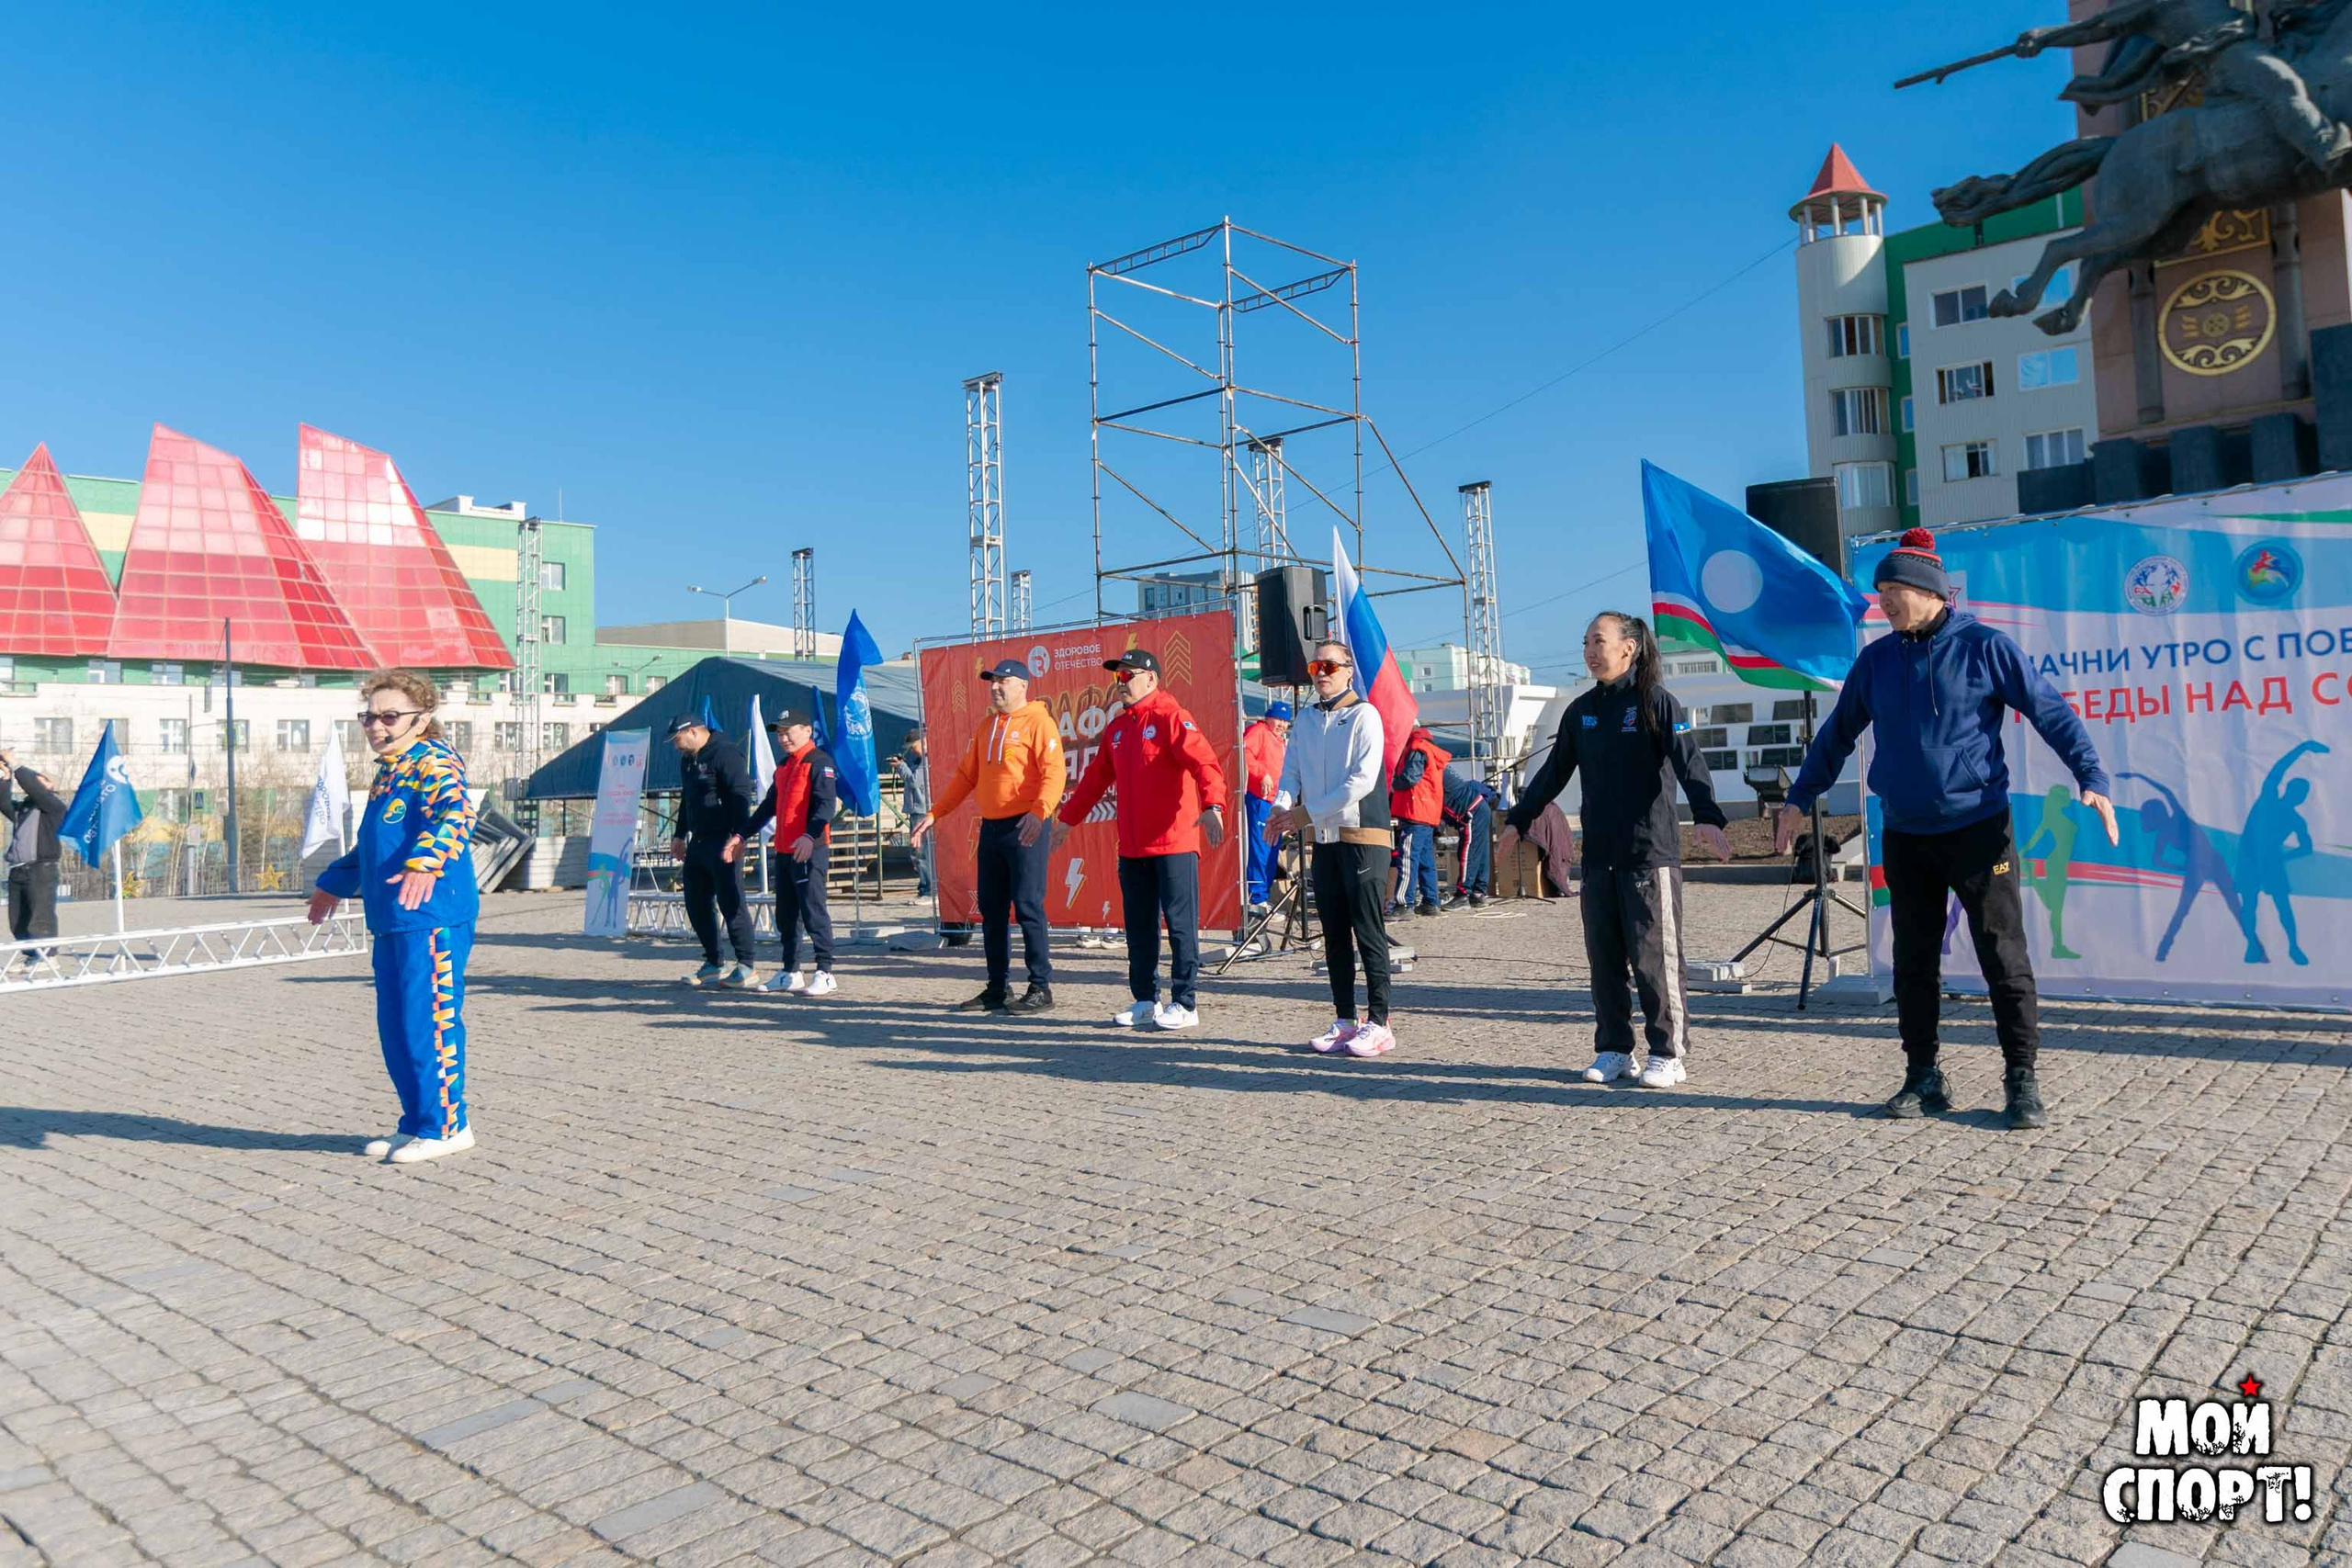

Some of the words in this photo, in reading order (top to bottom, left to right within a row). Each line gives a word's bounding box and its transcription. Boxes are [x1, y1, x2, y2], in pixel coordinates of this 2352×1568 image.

[1054, 643, 1101, 659] ЗДОРОВОЕ
[2028, 648, 2130, 676] АЧНИ
[2140, 637, 2231, 670] УТРО
[2244, 637, 2266, 660] С
[1054, 658, 1102, 671] ОТЕЧЕСТВО
[2185, 676, 2293, 716] НАД
[2311, 672, 2352, 705] С
[1993, 862, 2010, 875] EA7
